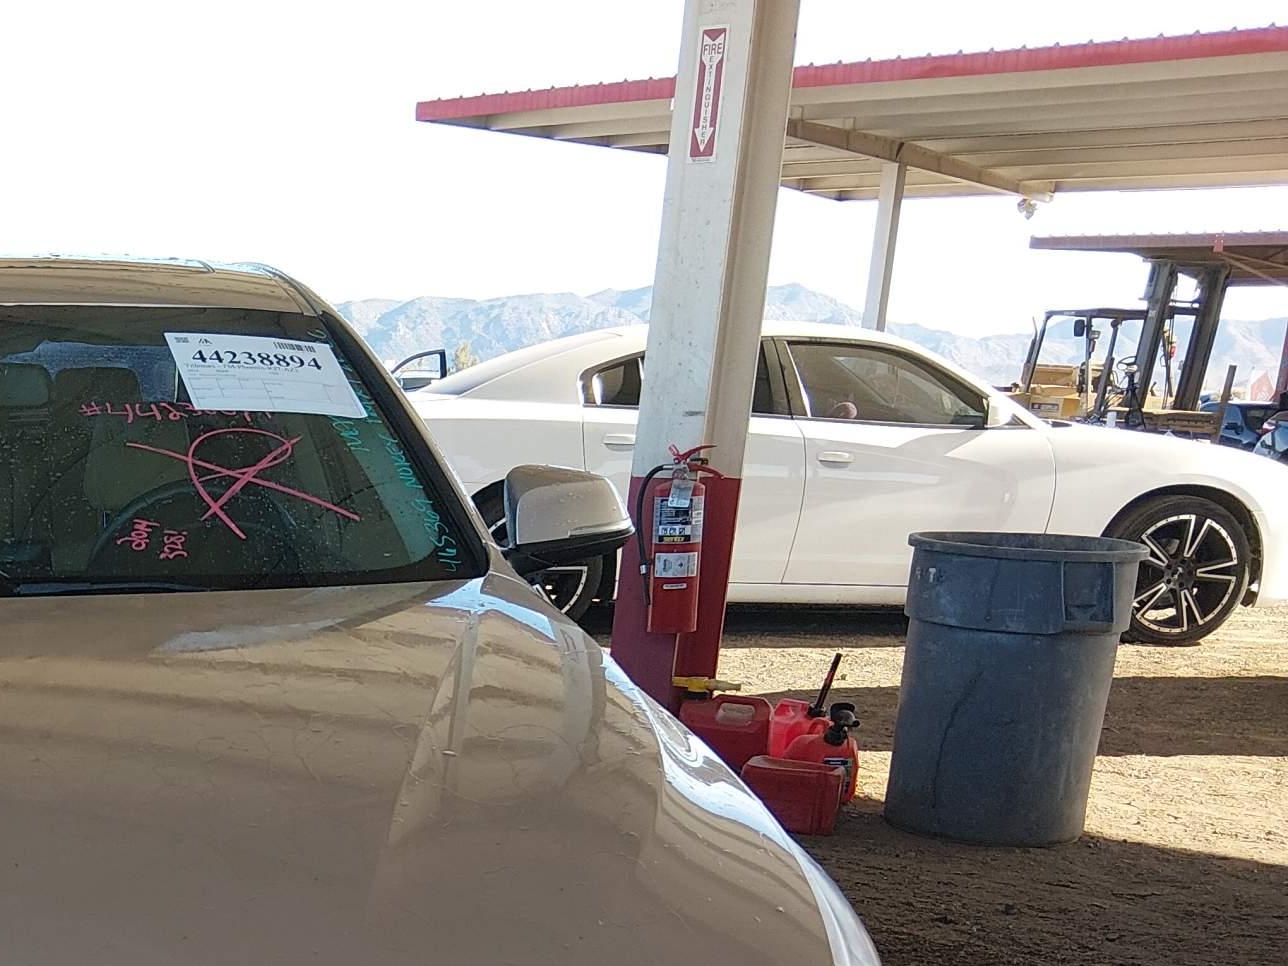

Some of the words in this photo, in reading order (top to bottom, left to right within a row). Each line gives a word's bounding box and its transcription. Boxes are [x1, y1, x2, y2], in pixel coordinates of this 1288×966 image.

[703, 43, 723, 55] FIRE
[700, 56, 714, 145] EXTINGUISHER
[192, 349, 322, 371] 44238894
